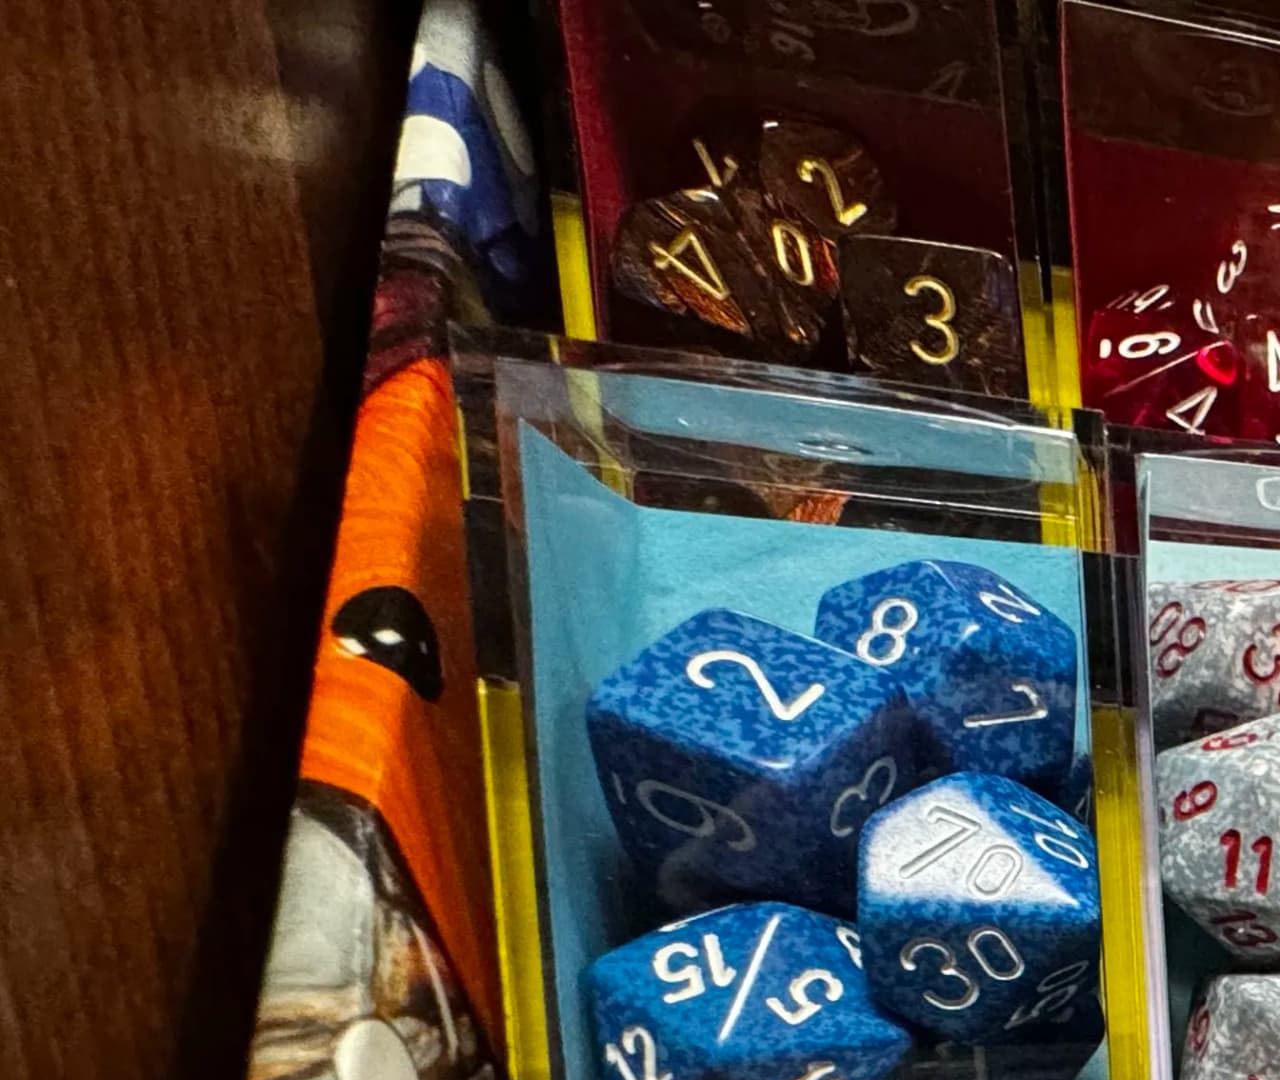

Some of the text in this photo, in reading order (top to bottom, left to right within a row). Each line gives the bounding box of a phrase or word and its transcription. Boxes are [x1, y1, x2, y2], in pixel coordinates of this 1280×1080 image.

[1217, 240, 1247, 293] 3
[903, 275, 961, 365] 3
[856, 599, 919, 667] 8
[686, 650, 826, 721] 2
[831, 756, 898, 838] 3
[899, 804, 1025, 897] 70
[1009, 804, 1091, 870] 10
[1219, 828, 1273, 896] 11
[653, 933, 737, 1005] 15
[765, 968, 845, 1026] 5
[900, 928, 1025, 1011] 30
